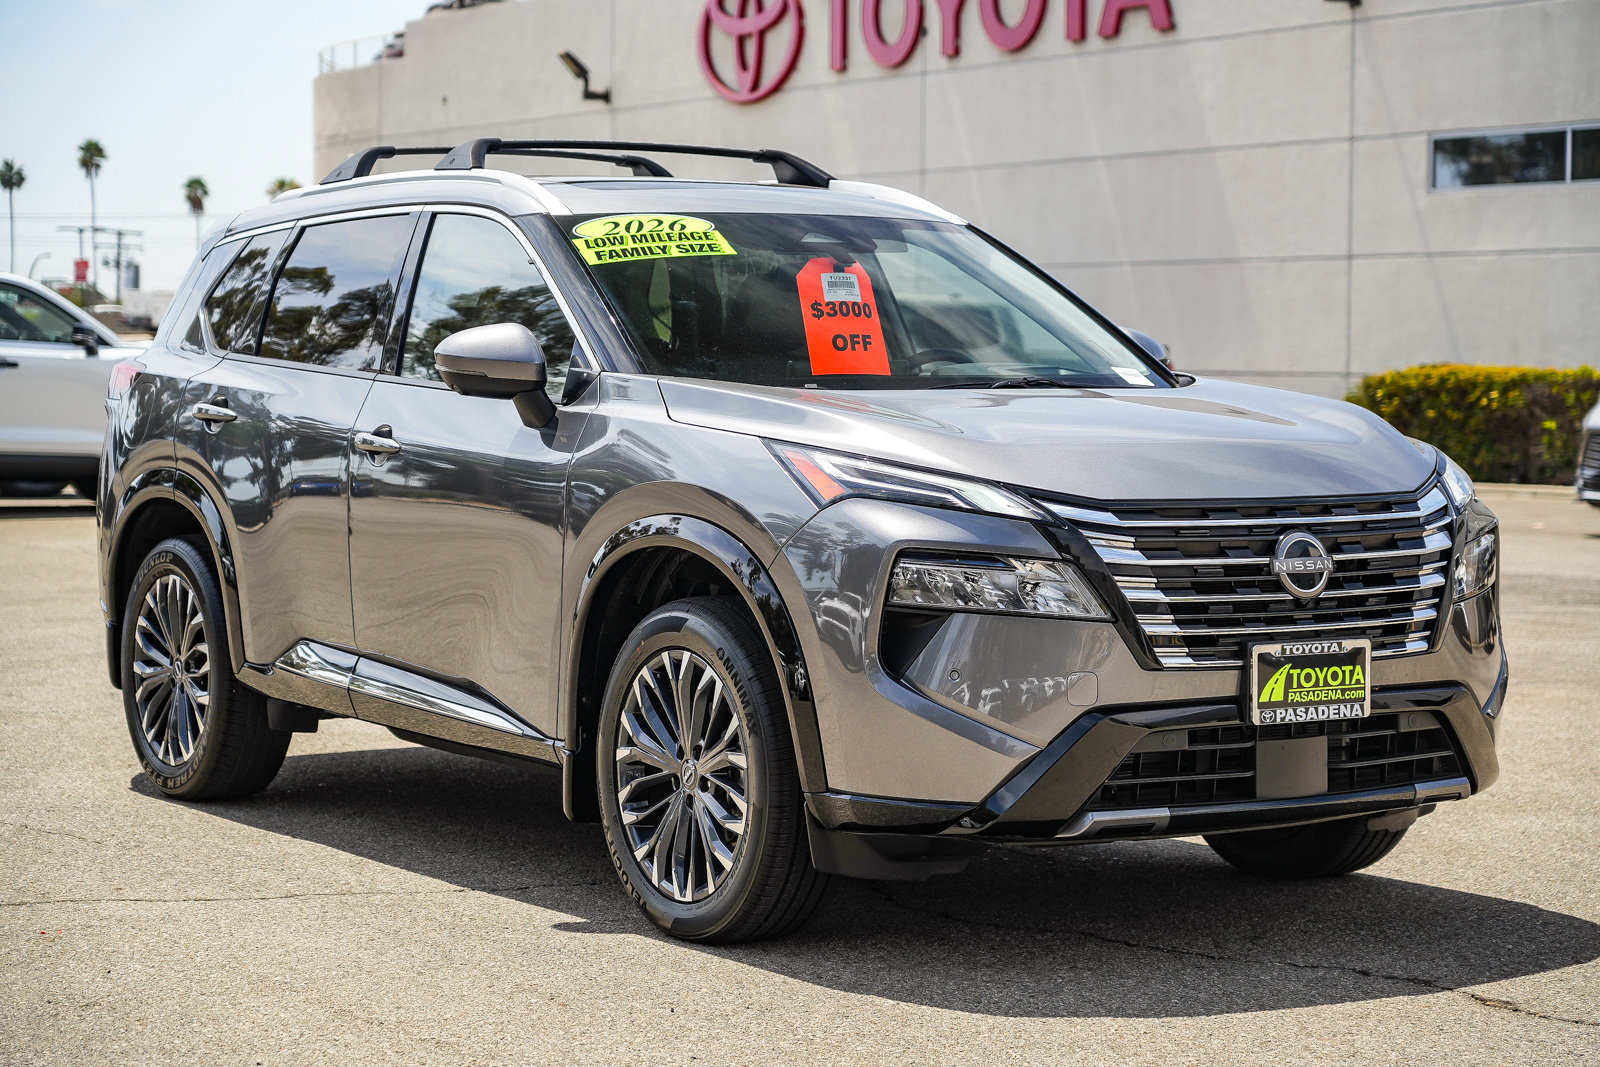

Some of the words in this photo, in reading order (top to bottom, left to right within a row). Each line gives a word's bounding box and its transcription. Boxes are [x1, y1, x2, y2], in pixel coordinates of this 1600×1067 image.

[602, 219, 687, 236] 2026
[583, 235, 625, 249] LOW
[631, 231, 715, 245] MILEAGE
[593, 244, 671, 261] FAMILY
[677, 243, 722, 254] SIZE
[810, 300, 873, 320] $3000
[832, 334, 873, 352] OFF
[138, 552, 174, 582] DUNLOP
[1275, 560, 1333, 571] NISSAN
[1283, 642, 1340, 655] TOYOTA
[1289, 665, 1364, 687] TOYOTA
[1289, 690, 1364, 702] PASADENA.com
[1276, 703, 1363, 723] PASADENA
